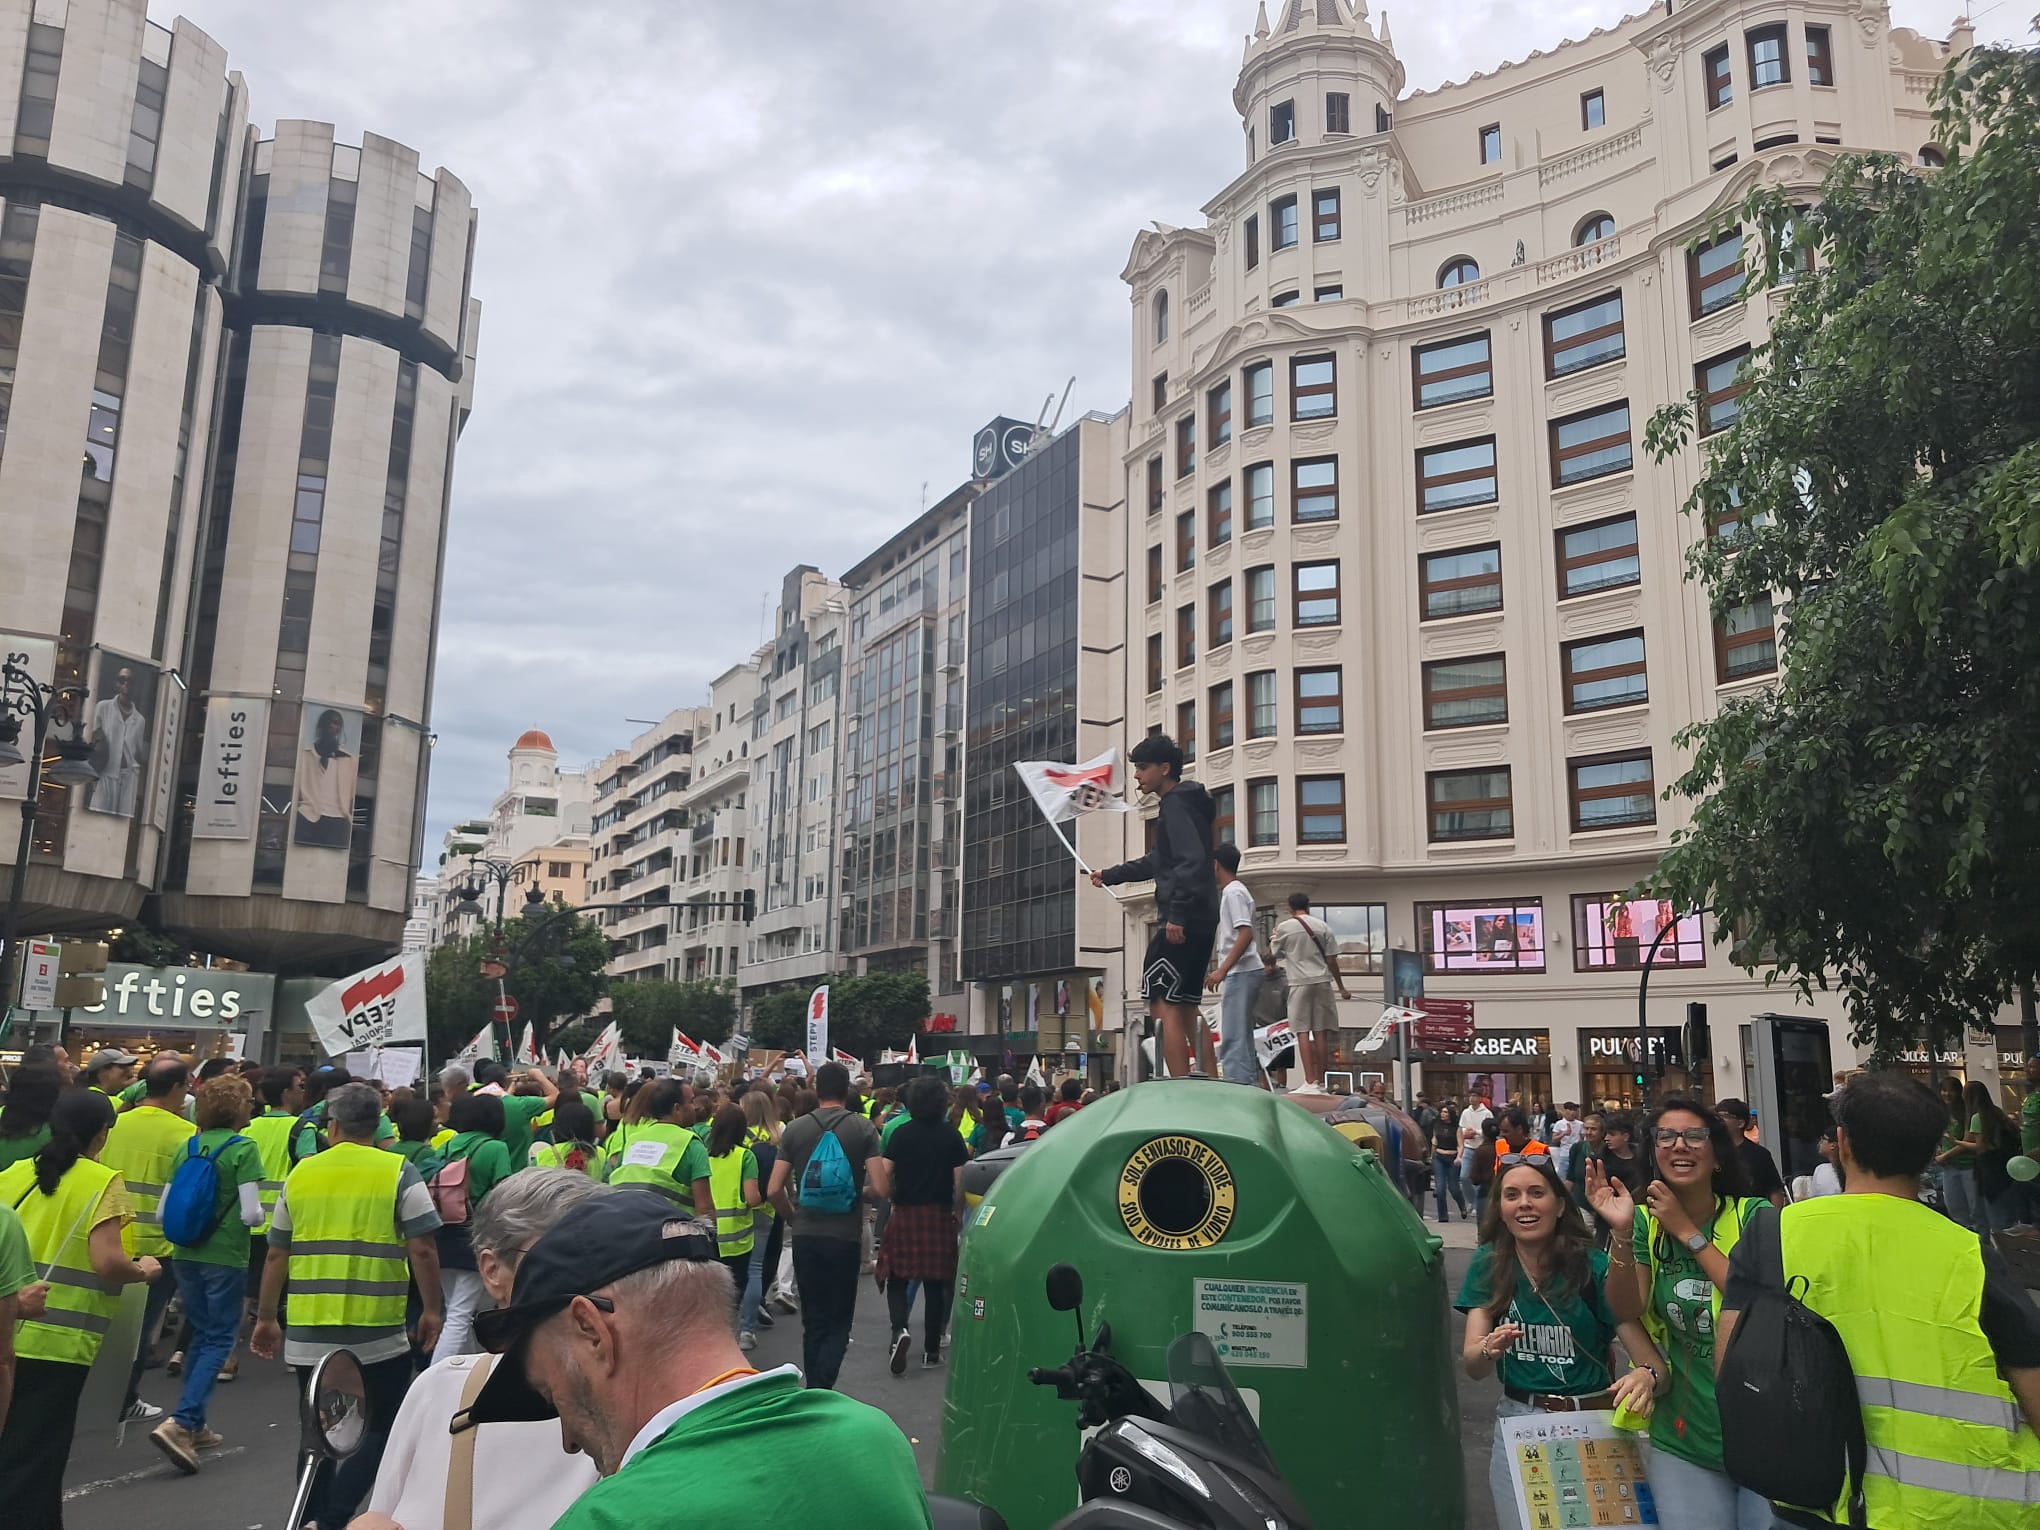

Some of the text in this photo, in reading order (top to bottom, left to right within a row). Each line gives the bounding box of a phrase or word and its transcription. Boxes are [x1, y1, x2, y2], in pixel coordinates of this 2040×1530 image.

[980, 442, 993, 461] SH
[214, 711, 247, 805] lefties
[810, 1022, 818, 1052] STEPV
[1123, 1138, 1233, 1190] SOLS ENVASOS DE VIDRE
[1121, 1201, 1232, 1248] SOLO ENVASES DE VIDRIO
[1204, 1283, 1246, 1293] CUALQUIER
[1201, 1293, 1216, 1301] ESTE
[1268, 1297, 1281, 1305] POR
[1232, 1330, 1245, 1338] 900
[1259, 1331, 1272, 1339] 700
[1517, 1352, 1574, 1365] ES TOCA
